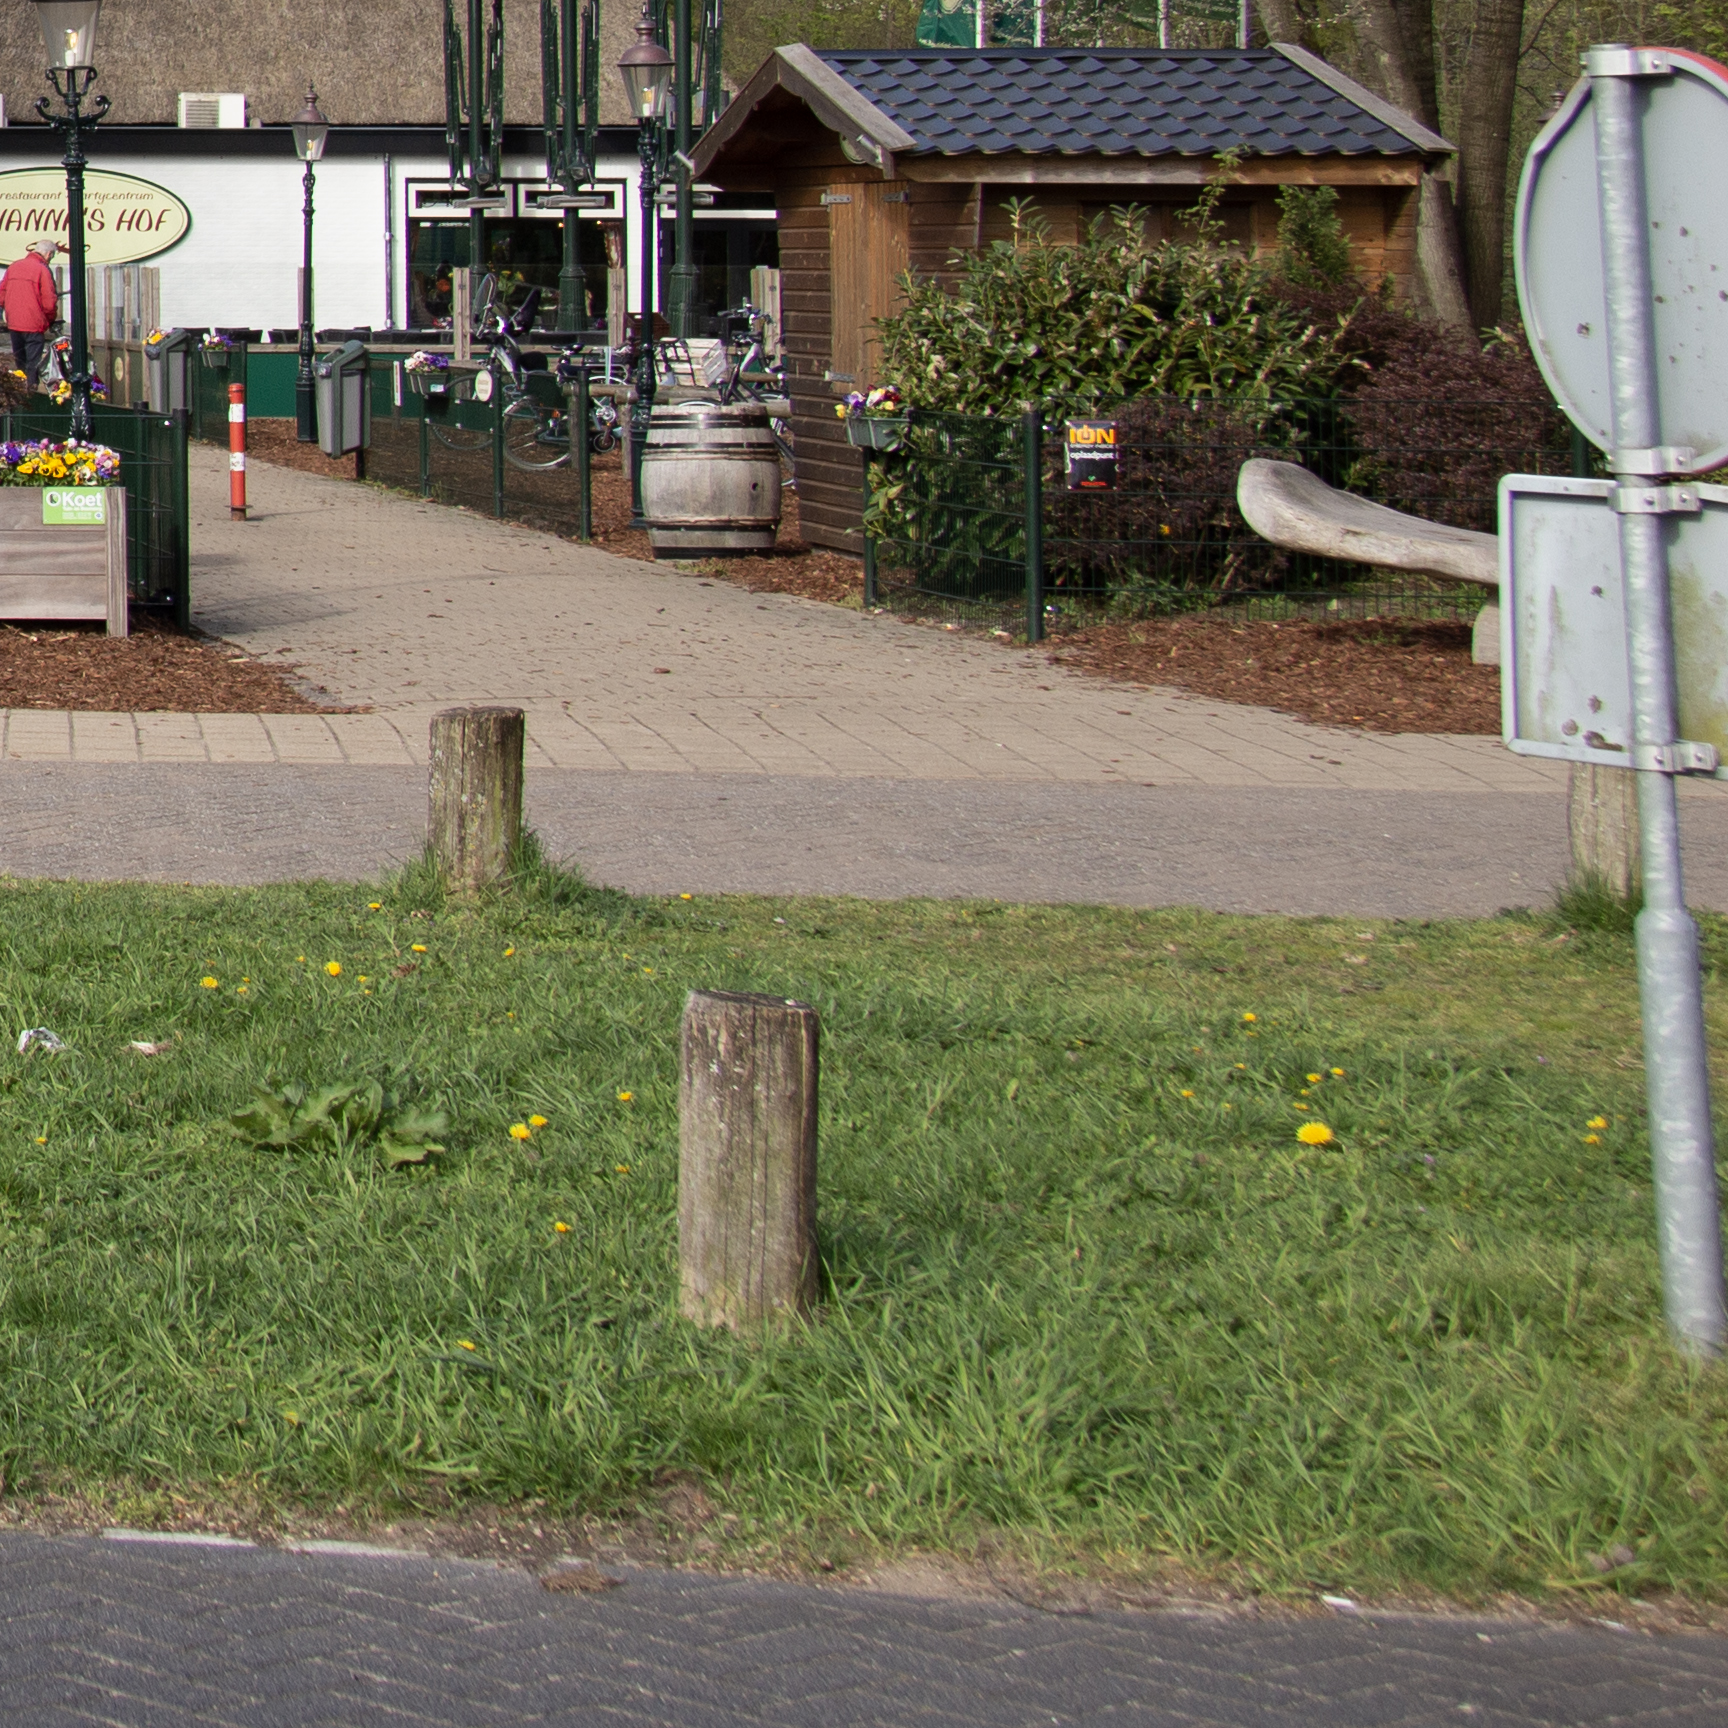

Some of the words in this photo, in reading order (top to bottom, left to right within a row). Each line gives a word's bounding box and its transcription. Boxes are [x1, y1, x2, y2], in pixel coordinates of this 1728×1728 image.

[0, 191, 62, 200] restaurant
[84, 191, 154, 204] rtycentrum
[115, 208, 172, 232] HOF
[1069, 424, 1115, 444] ION
[1070, 450, 1115, 461] oplaadpunt
[62, 491, 102, 507] Koet
